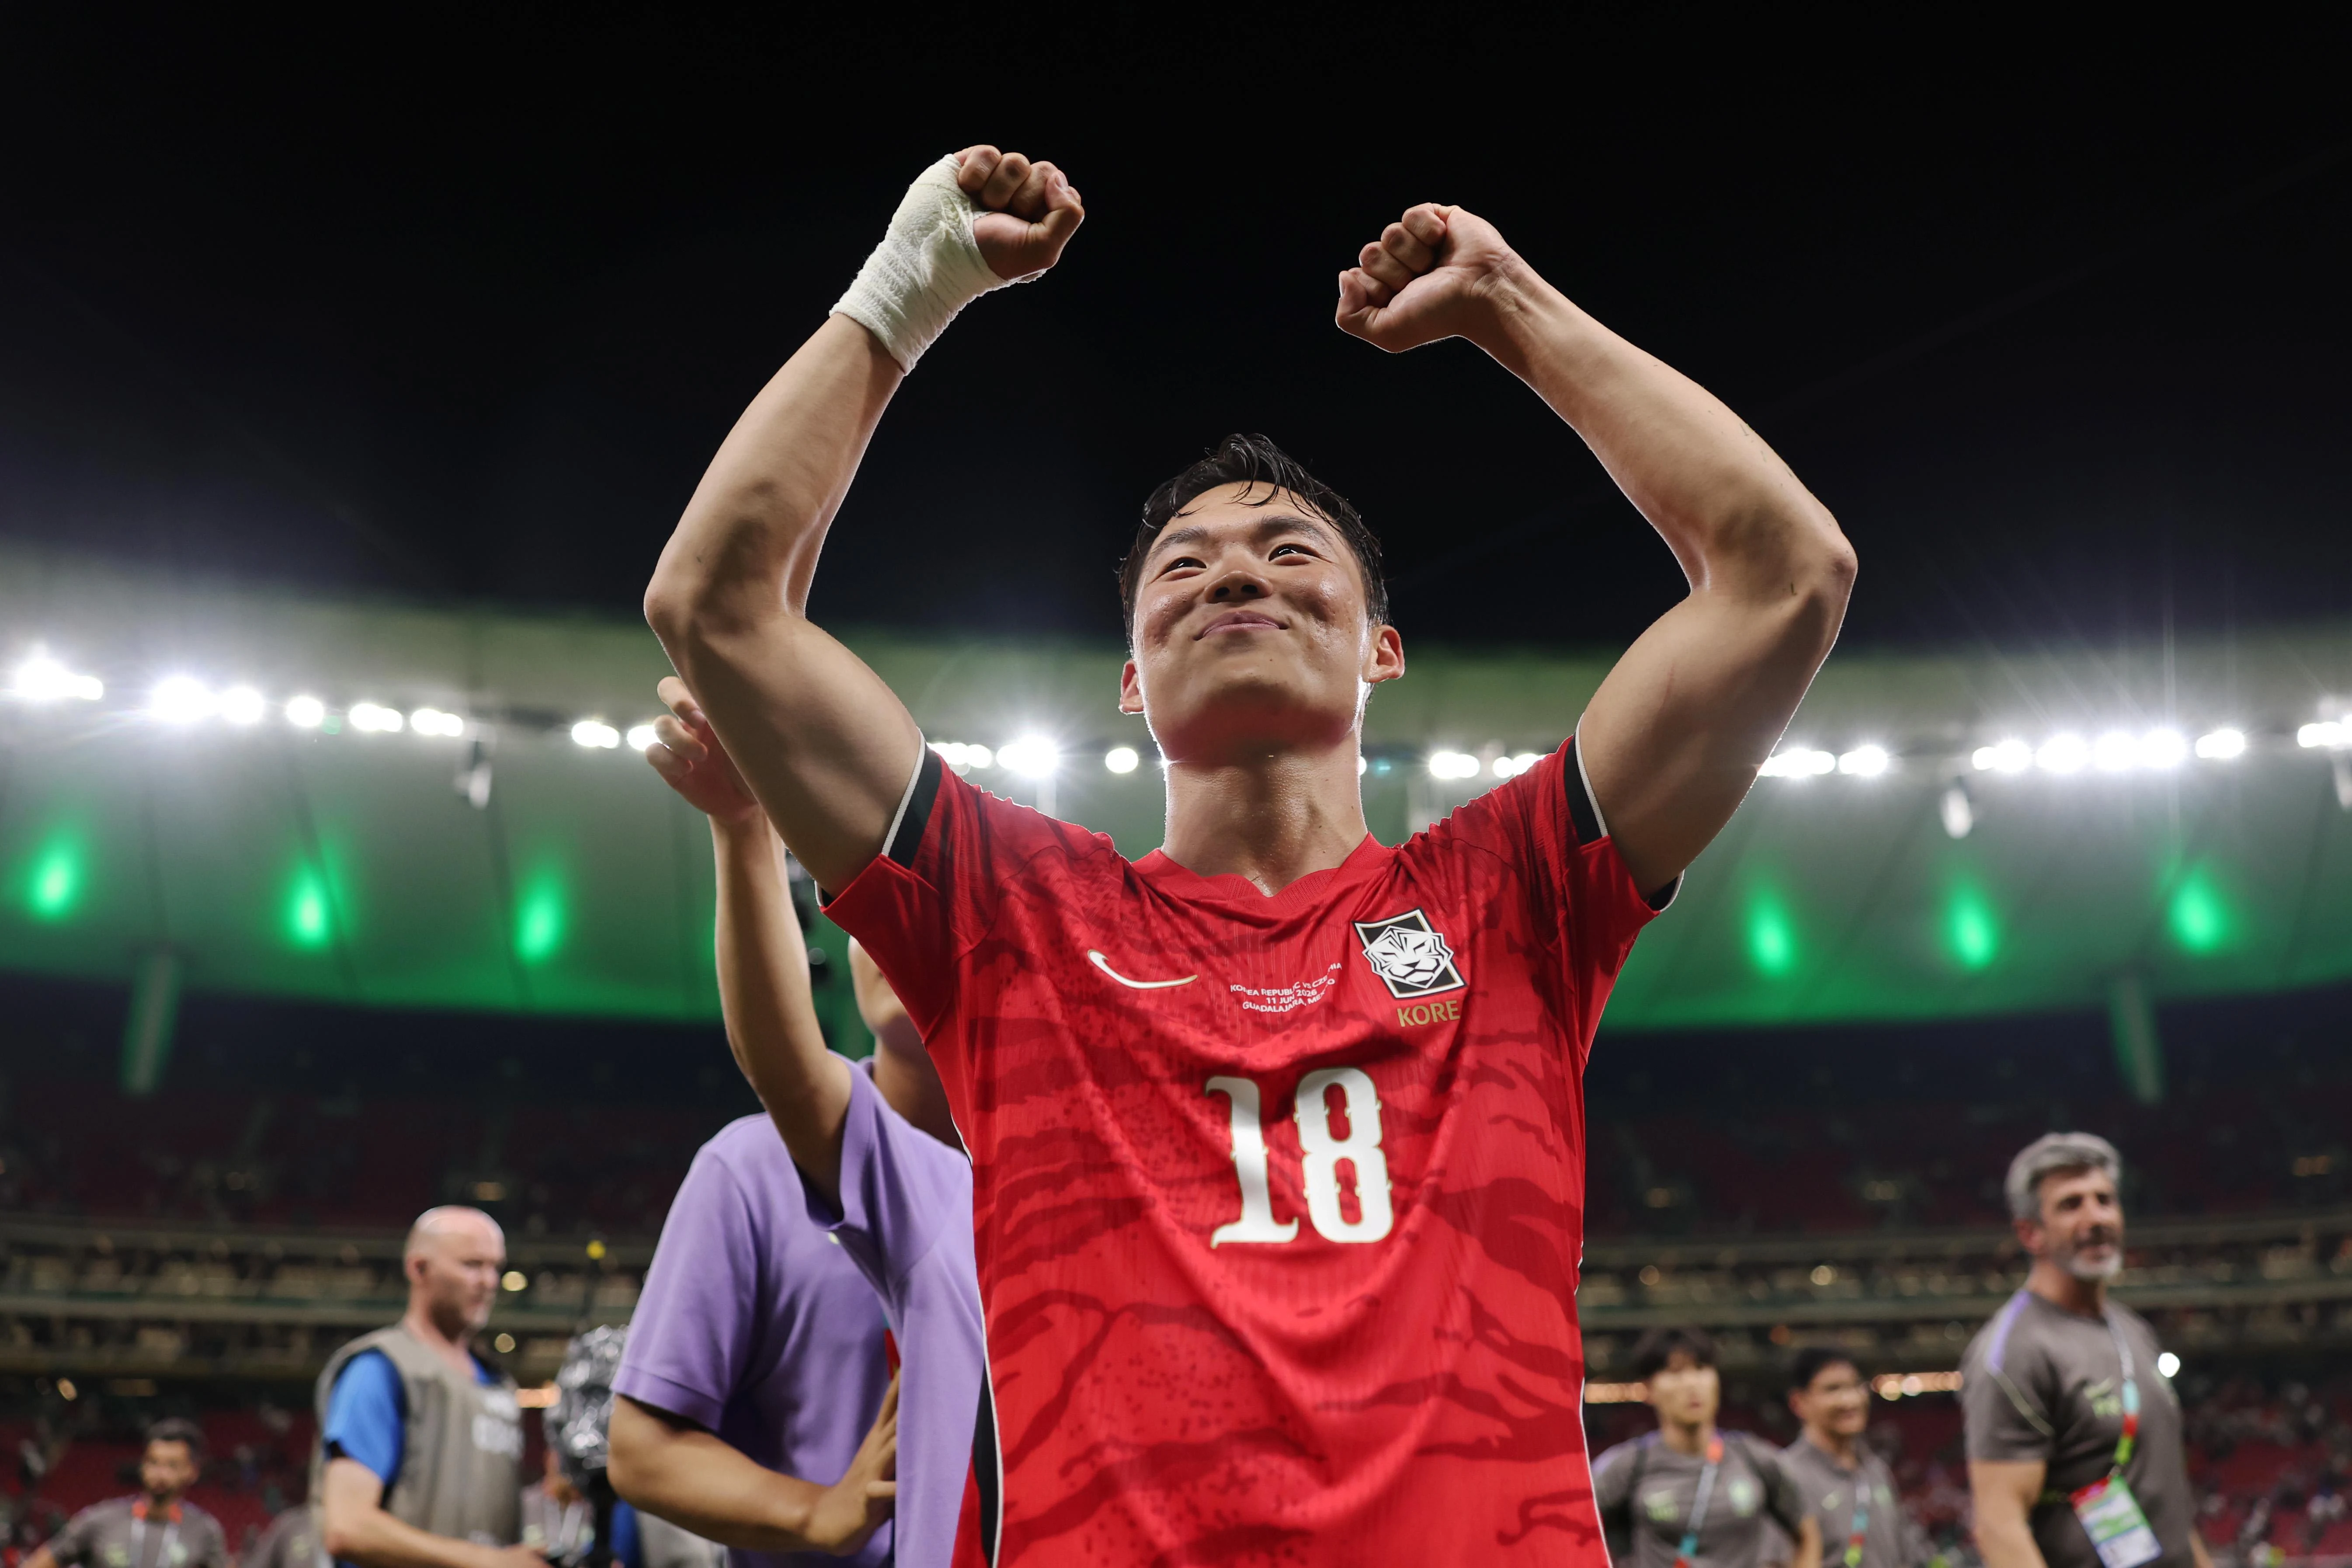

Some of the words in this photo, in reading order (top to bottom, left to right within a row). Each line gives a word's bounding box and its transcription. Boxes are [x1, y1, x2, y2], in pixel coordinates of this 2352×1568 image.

[1242, 998, 1306, 1012] GUADALAJARA,
[1279, 994, 1295, 1004] JUN
[1397, 1000, 1460, 1027] KORE
[1205, 1067, 1394, 1249] 18
